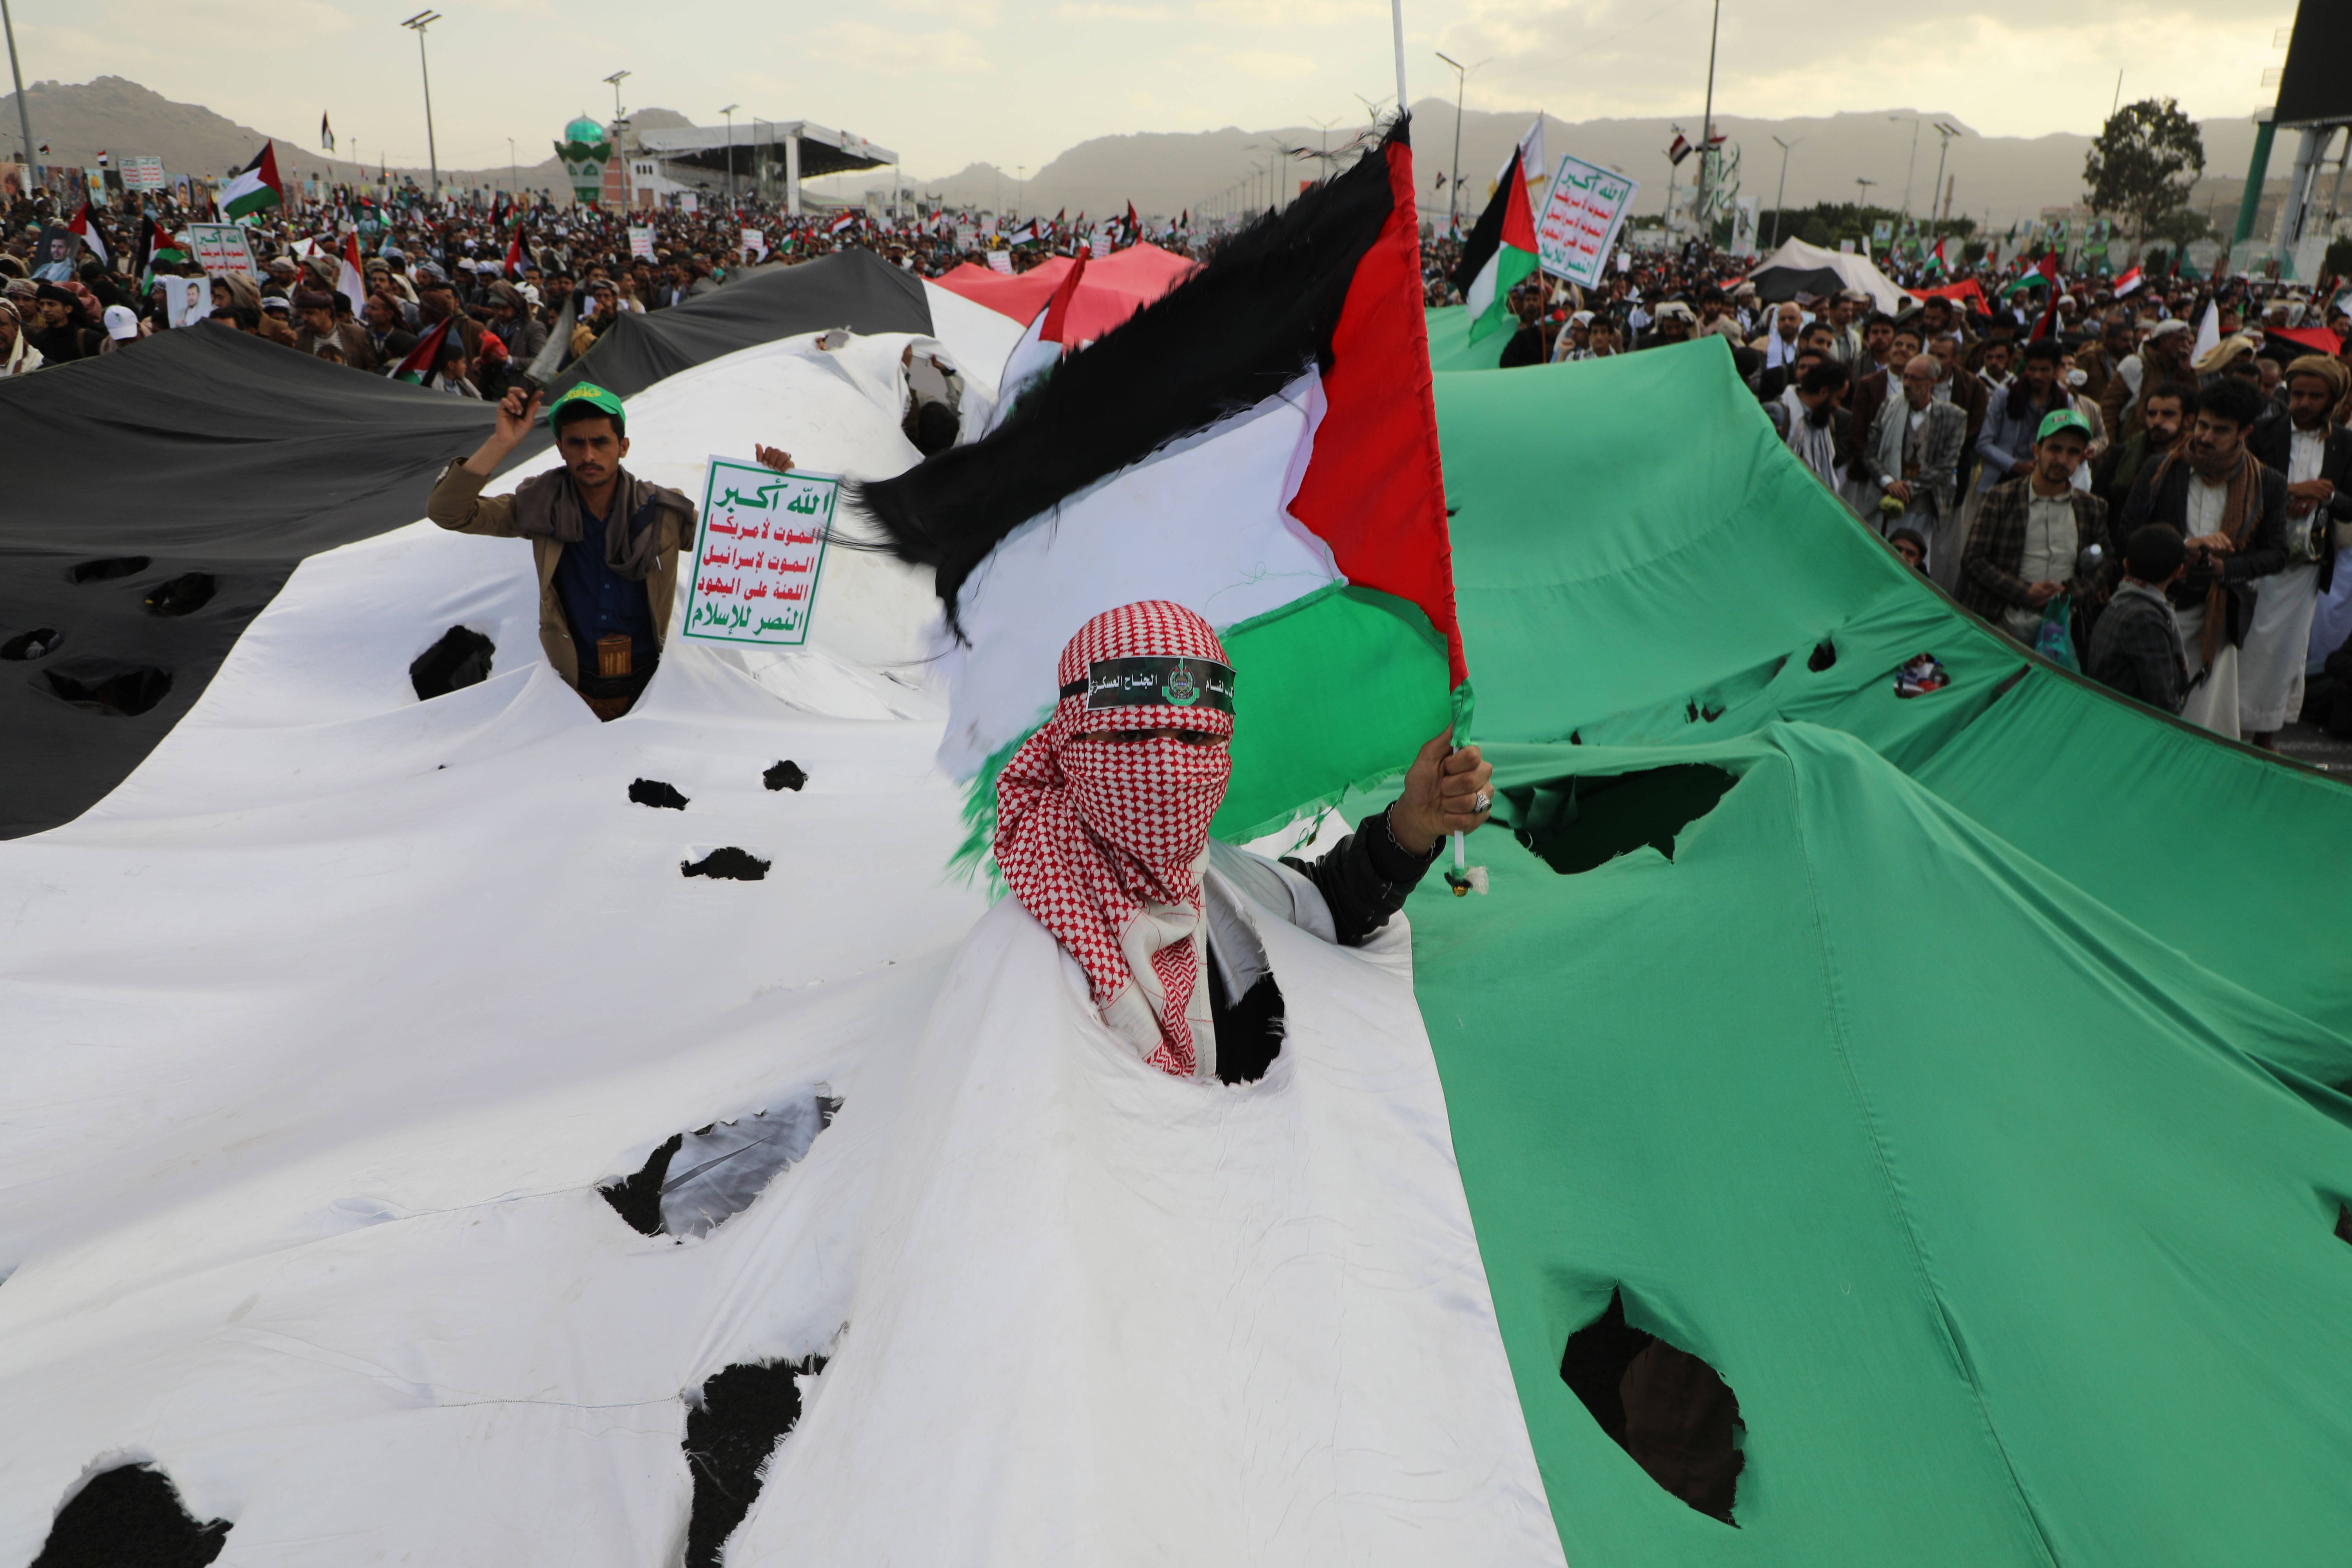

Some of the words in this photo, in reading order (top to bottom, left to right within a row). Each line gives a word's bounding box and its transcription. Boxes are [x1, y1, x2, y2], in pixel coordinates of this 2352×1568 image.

[1598, 181, 1625, 203] الله
[713, 478, 789, 513] أكبر
[787, 488, 830, 515] الله
[709, 514, 771, 540] لأمريكا
[774, 526, 821, 546] الموت
[702, 544, 765, 573] لإسرائيل
[768, 555, 815, 575] الموت
[697, 576, 741, 598] اليهود
[773, 581, 809, 601] اللعنة
[692, 601, 752, 636] للإسلام
[753, 606, 804, 636] النصر
[1089, 674, 1123, 696] العسكري
[1124, 672, 1157, 691] الجناح
[1205, 677, 1225, 693] القسام
